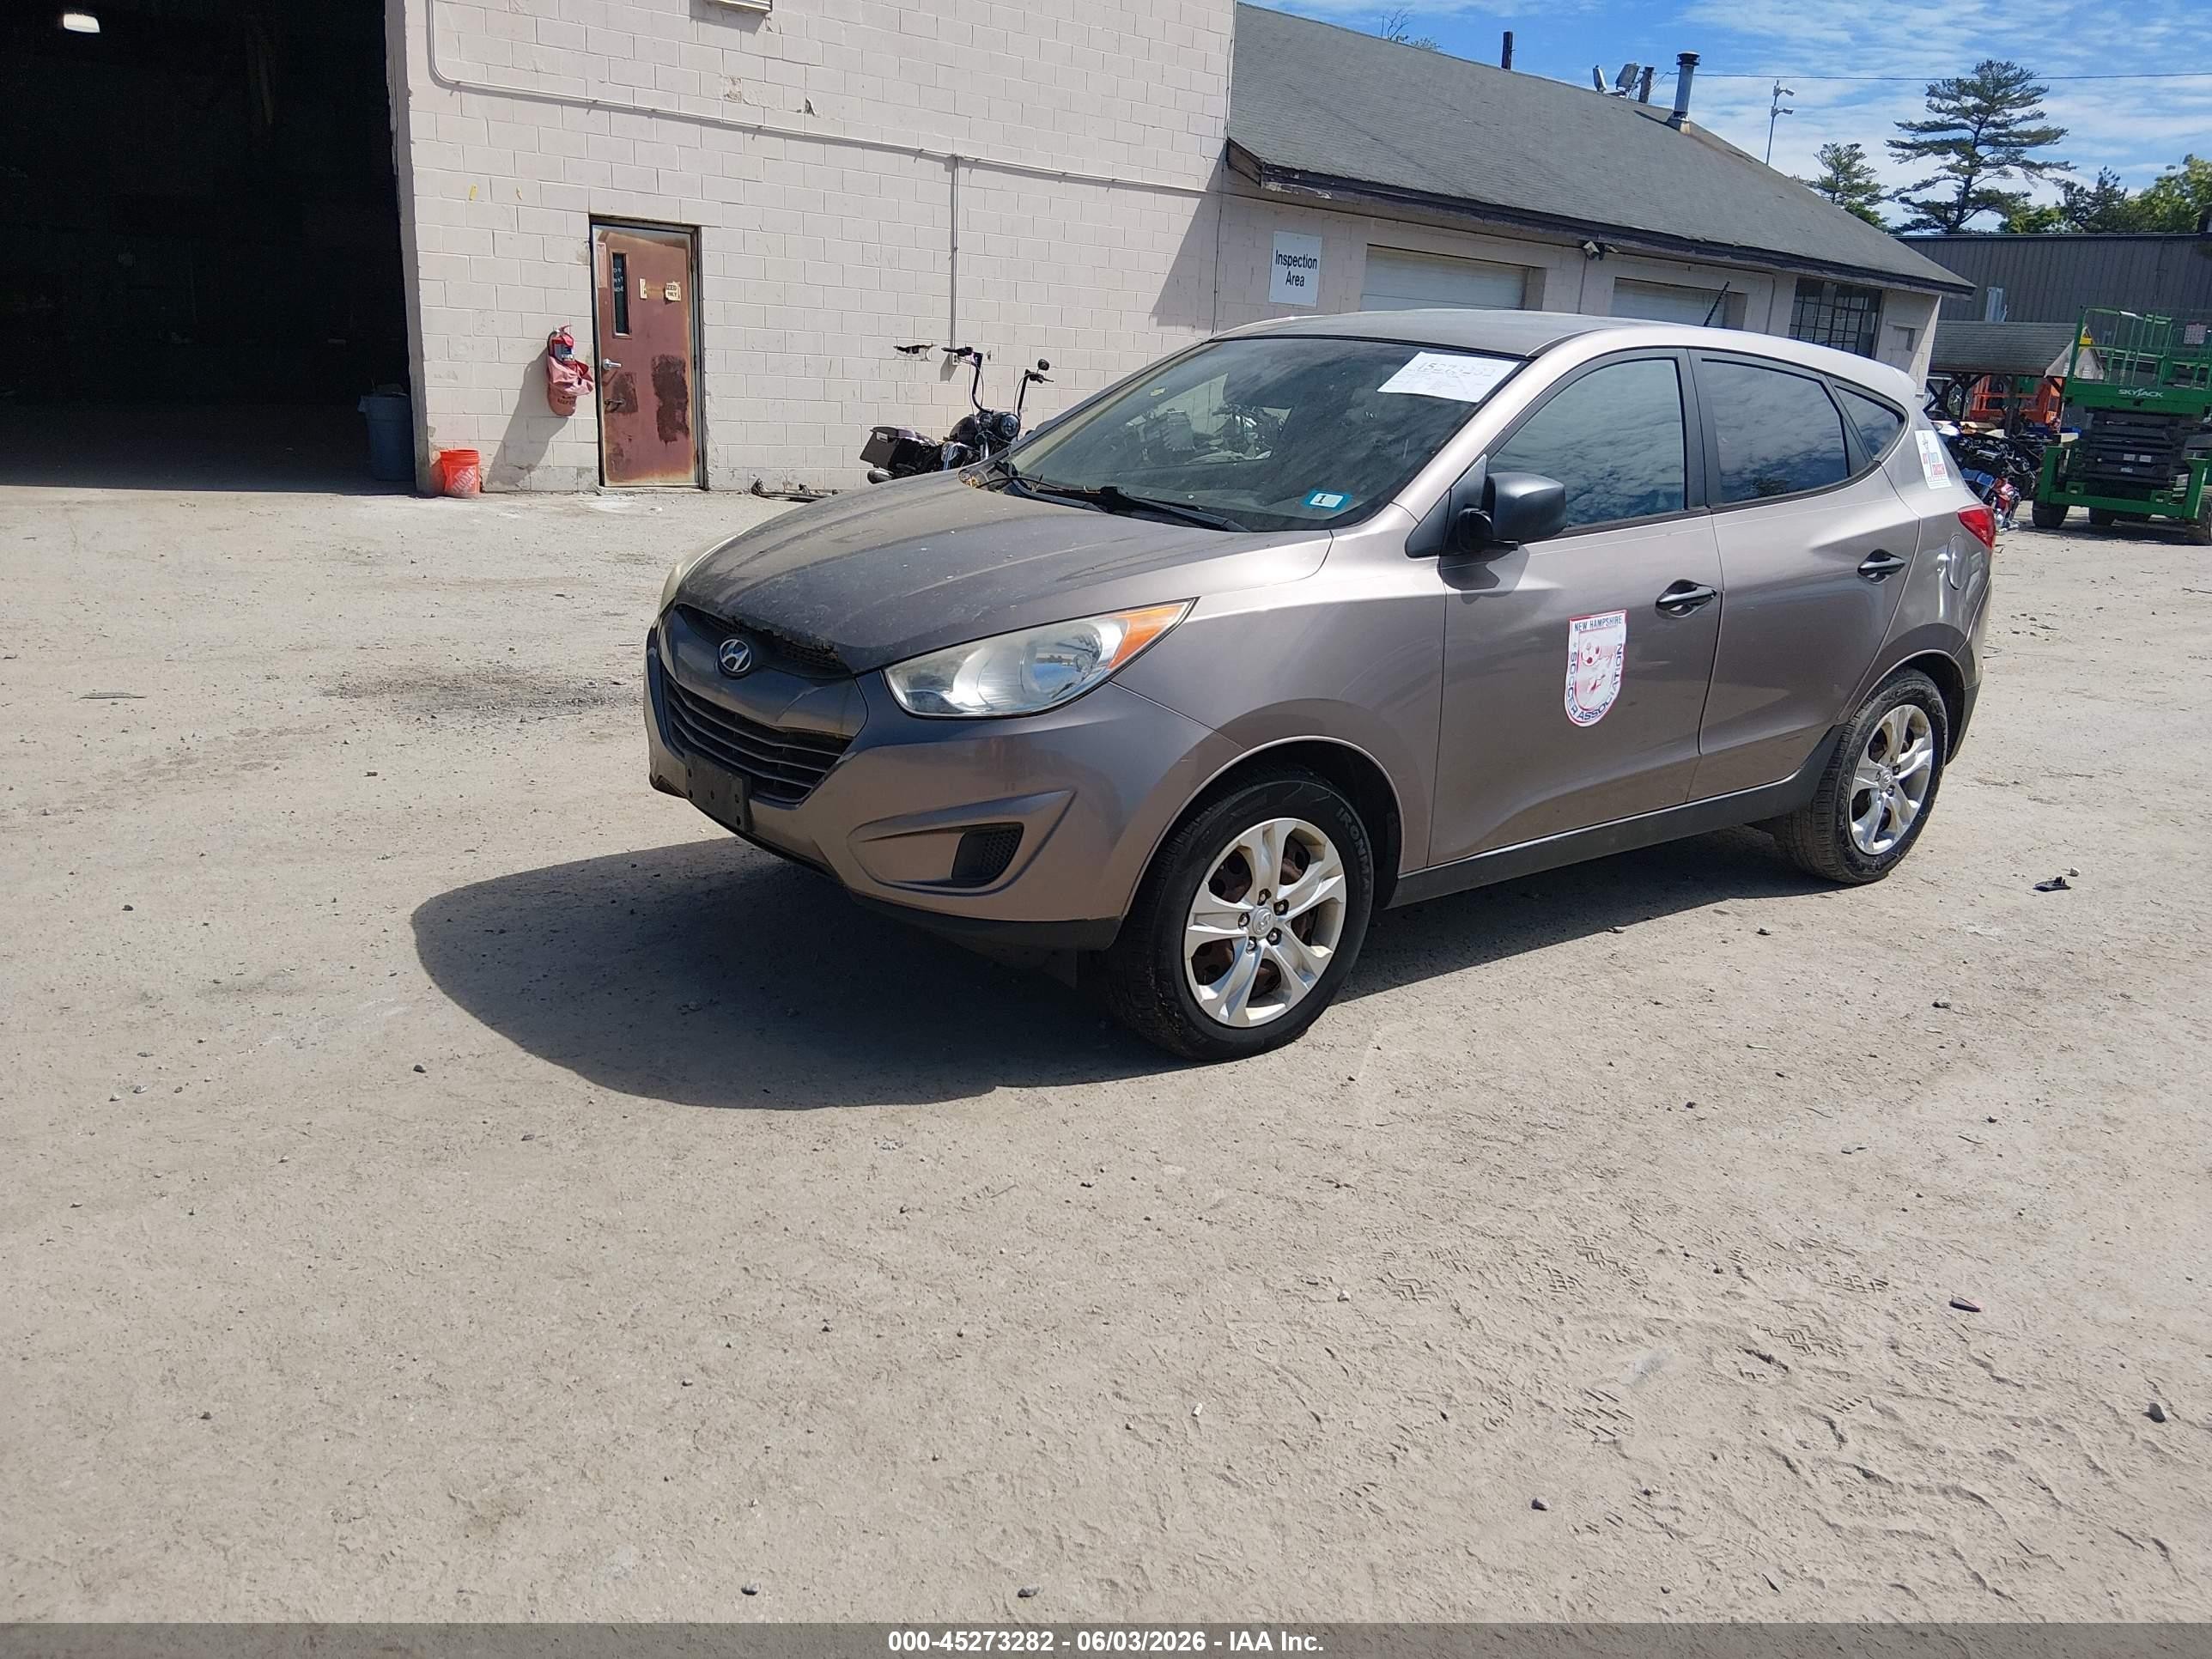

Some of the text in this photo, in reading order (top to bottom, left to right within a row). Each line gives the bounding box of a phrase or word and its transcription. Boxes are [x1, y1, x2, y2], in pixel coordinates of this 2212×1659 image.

[1275, 249, 1318, 270] Inspection
[1285, 270, 1305, 287] Area
[2118, 387, 2164, 398] SKYJACK
[1314, 495, 1327, 504] 1
[1574, 615, 1622, 632] NEW HAMPSHIRE
[1567, 642, 1623, 720] SOCCER ASSOCIATION
